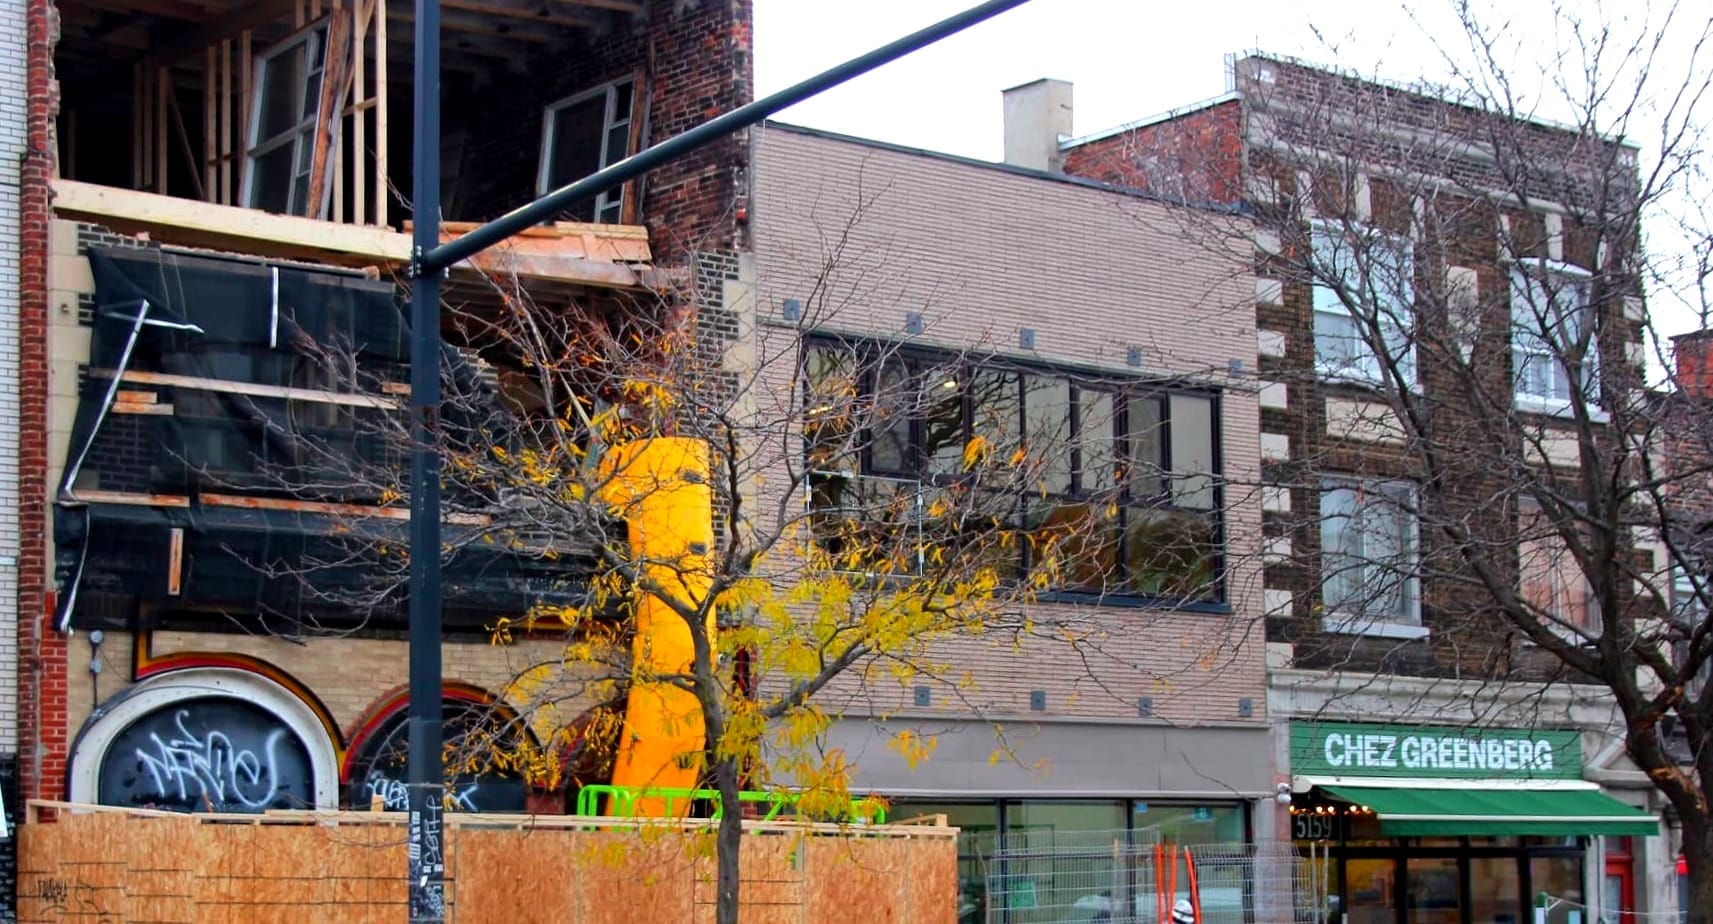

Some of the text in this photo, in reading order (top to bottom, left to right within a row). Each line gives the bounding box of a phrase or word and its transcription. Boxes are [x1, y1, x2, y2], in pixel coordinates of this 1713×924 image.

[1324, 733, 1553, 770] CHEZ GREENBERG
[1296, 813, 1332, 838] 5159
